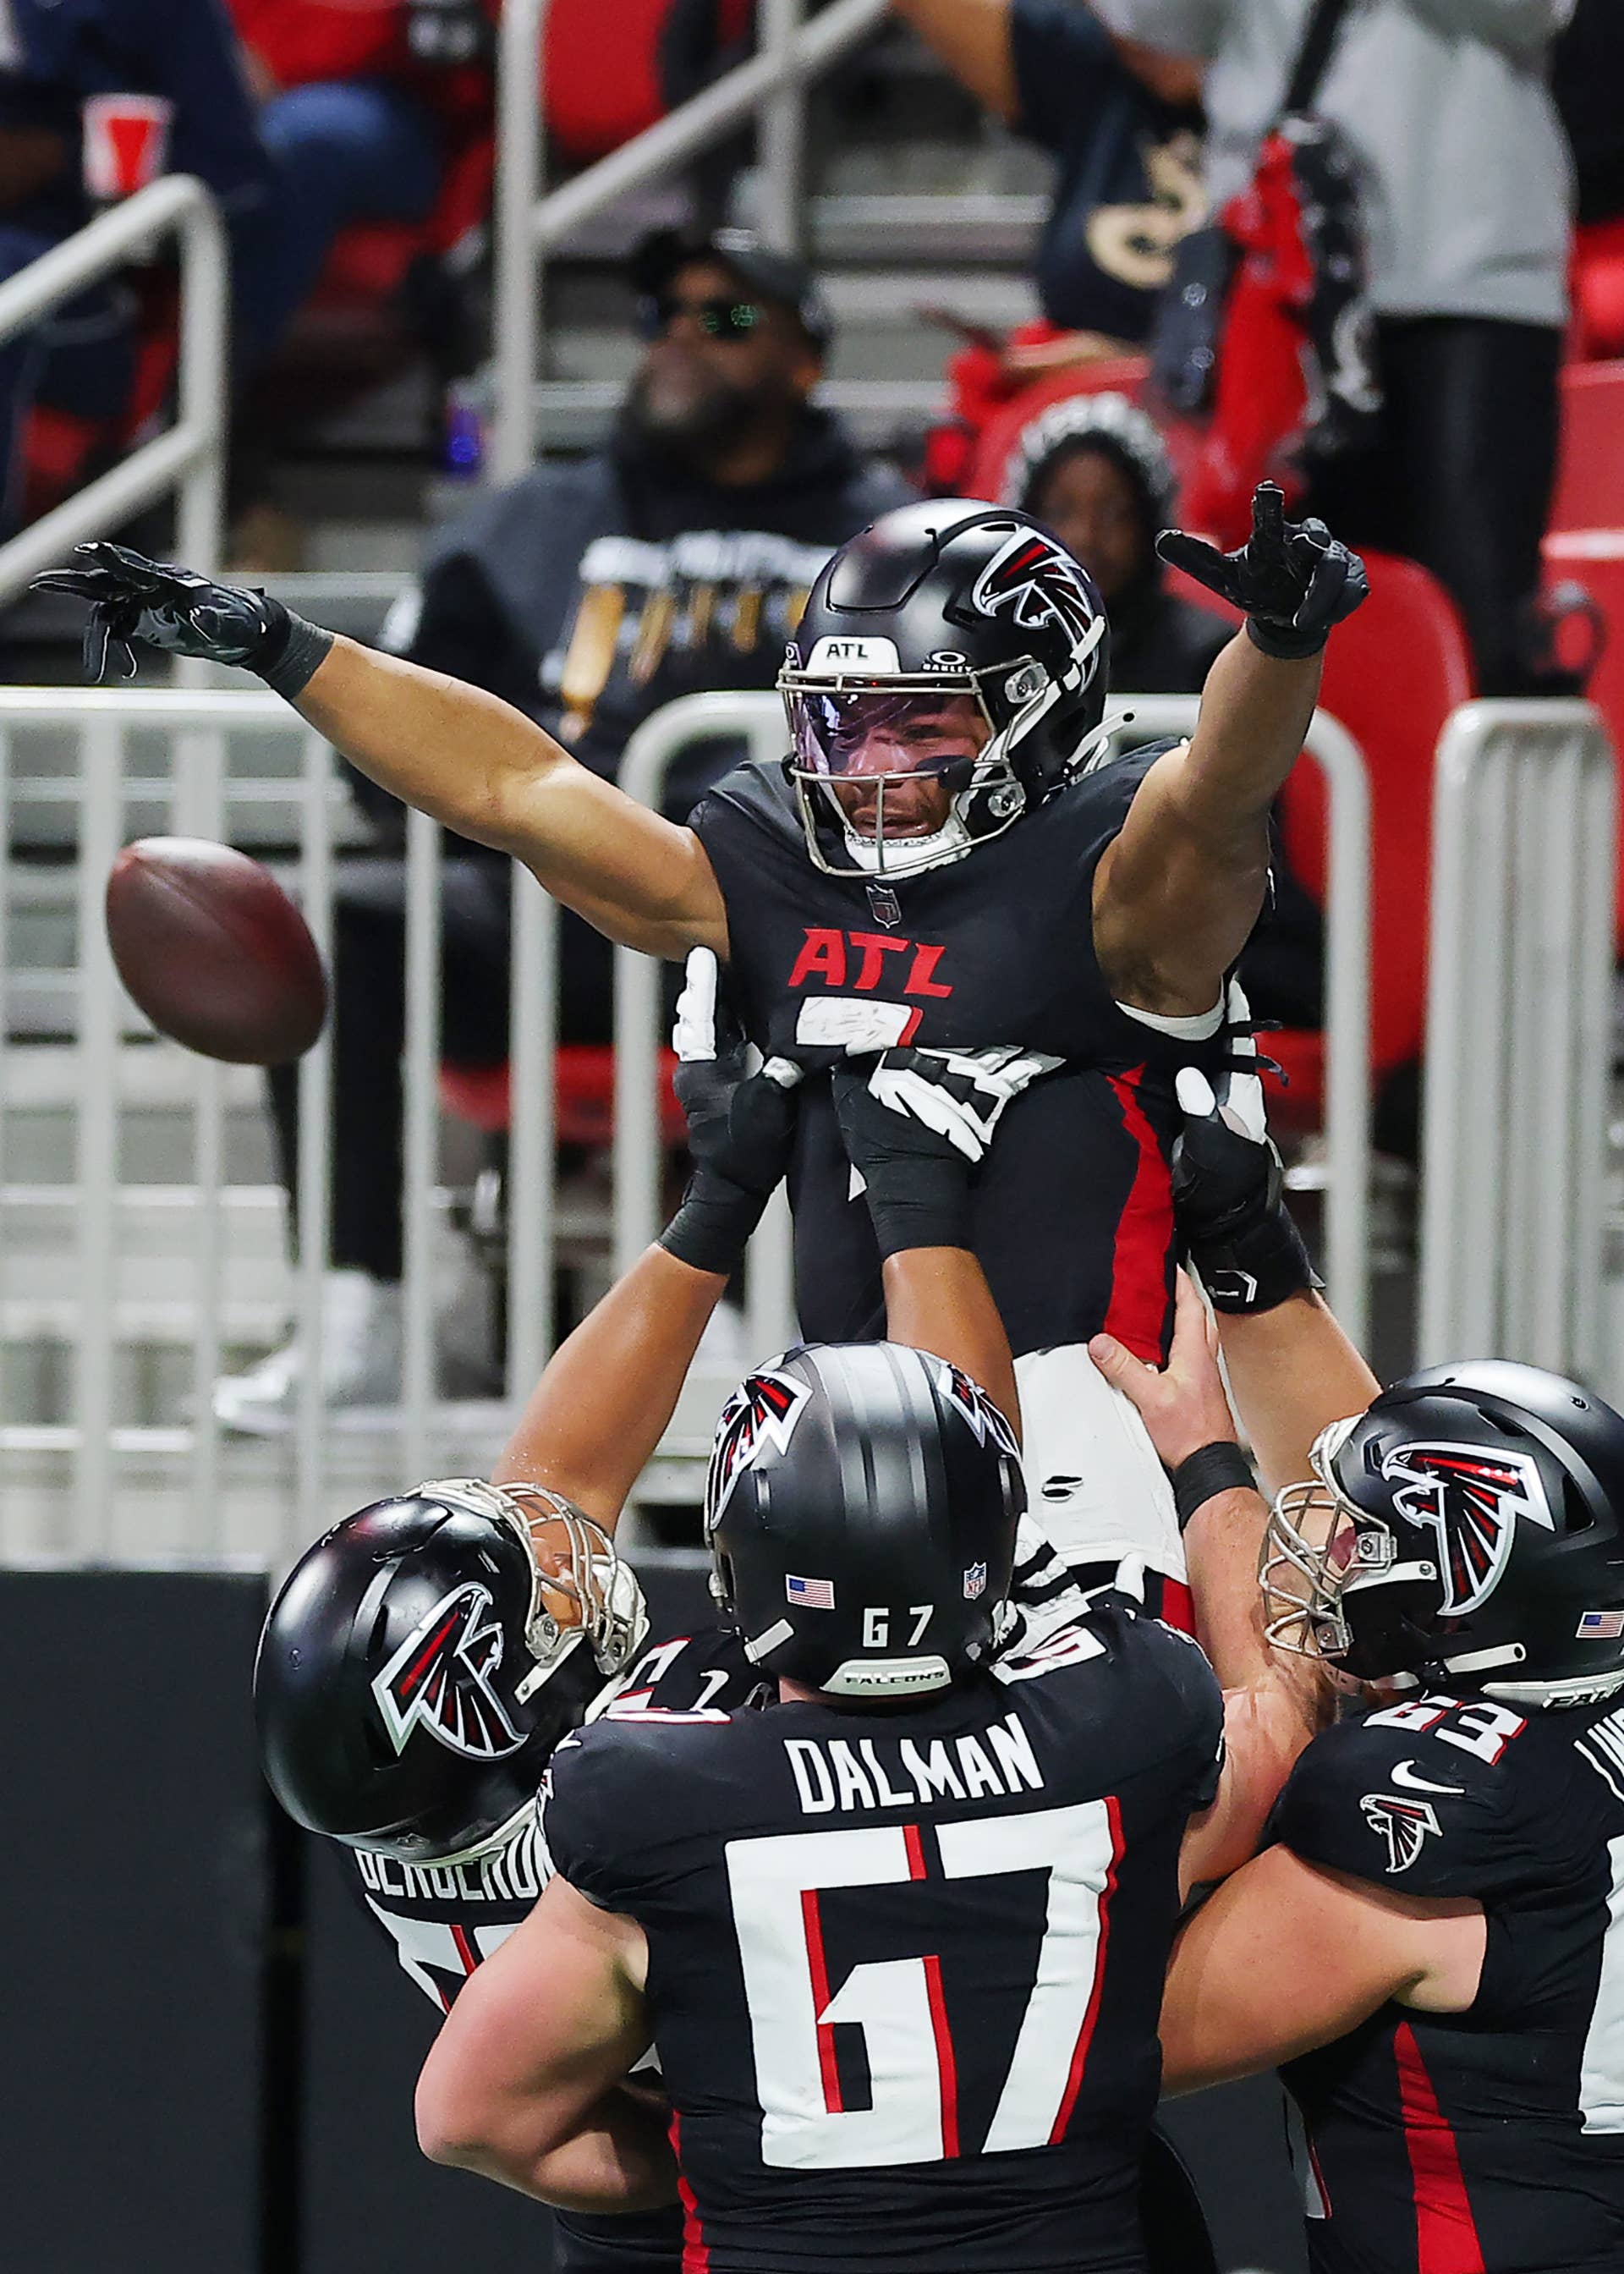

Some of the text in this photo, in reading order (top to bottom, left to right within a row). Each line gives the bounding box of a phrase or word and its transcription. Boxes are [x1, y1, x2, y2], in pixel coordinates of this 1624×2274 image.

[826, 643, 870, 659] ATL
[922, 663, 973, 674] OAKLEY
[787, 928, 954, 999] ATL
[863, 1604, 935, 1648] 67
[844, 1666, 946, 1685] FALCONS
[783, 1712, 1044, 1815] DALMAN
[725, 1795, 1126, 2170] 67
